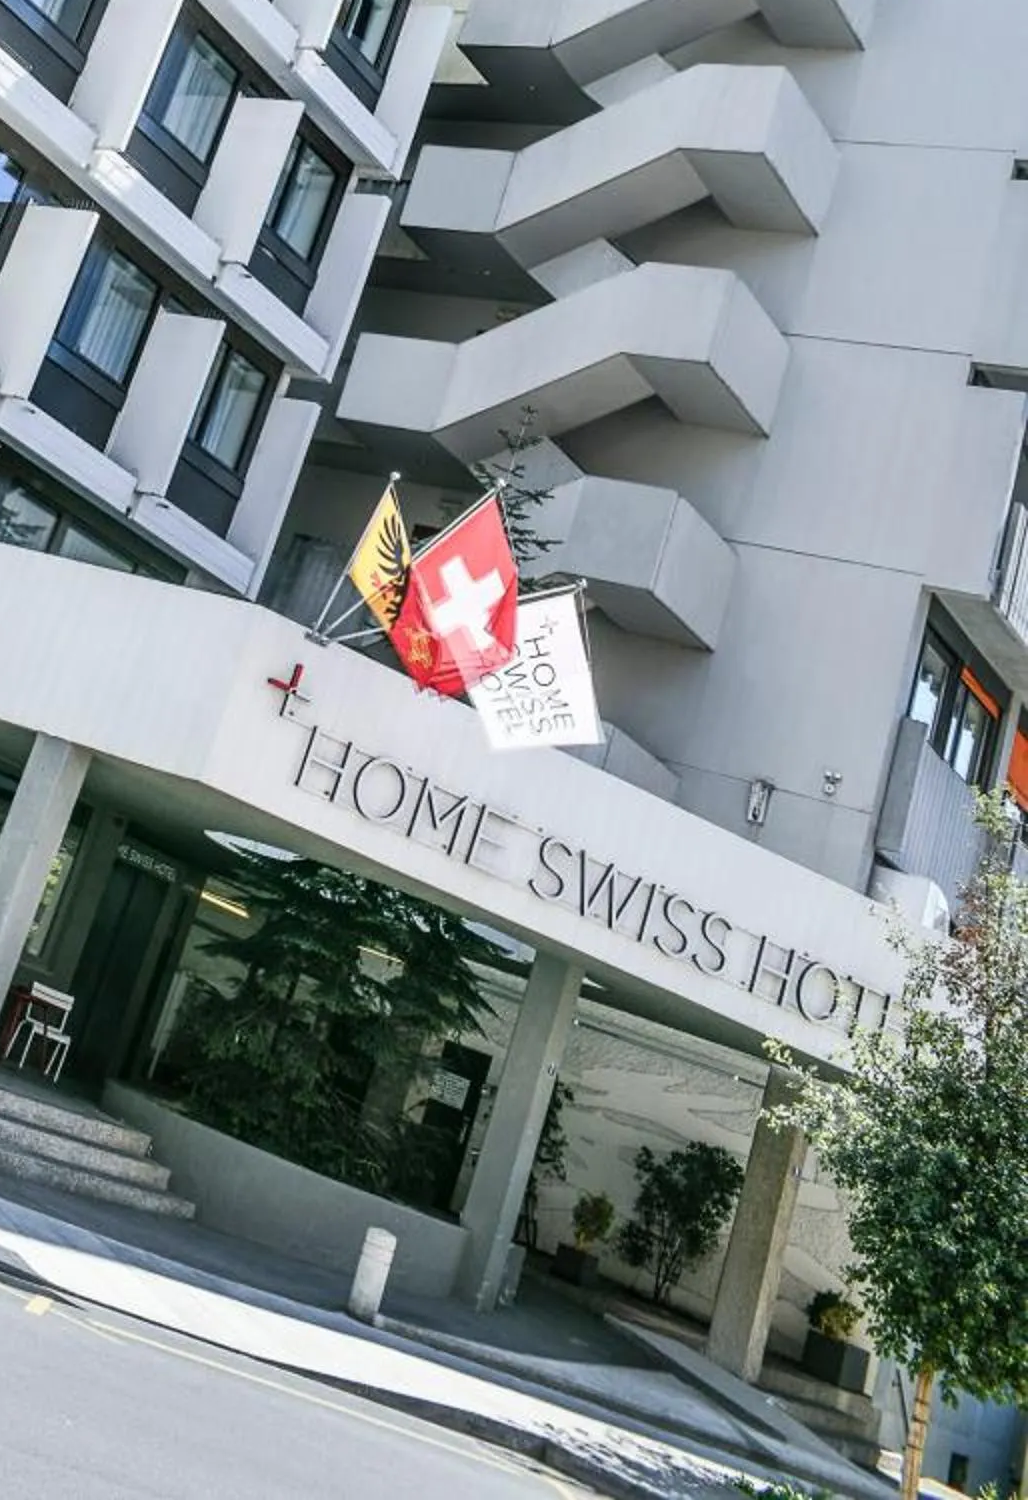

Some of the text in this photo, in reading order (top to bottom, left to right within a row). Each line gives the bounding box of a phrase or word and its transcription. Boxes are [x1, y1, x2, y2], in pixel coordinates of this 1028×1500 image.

[523, 636, 576, 731] HOME
[294, 725, 520, 870] HOME
[528, 835, 733, 974] SWISS
